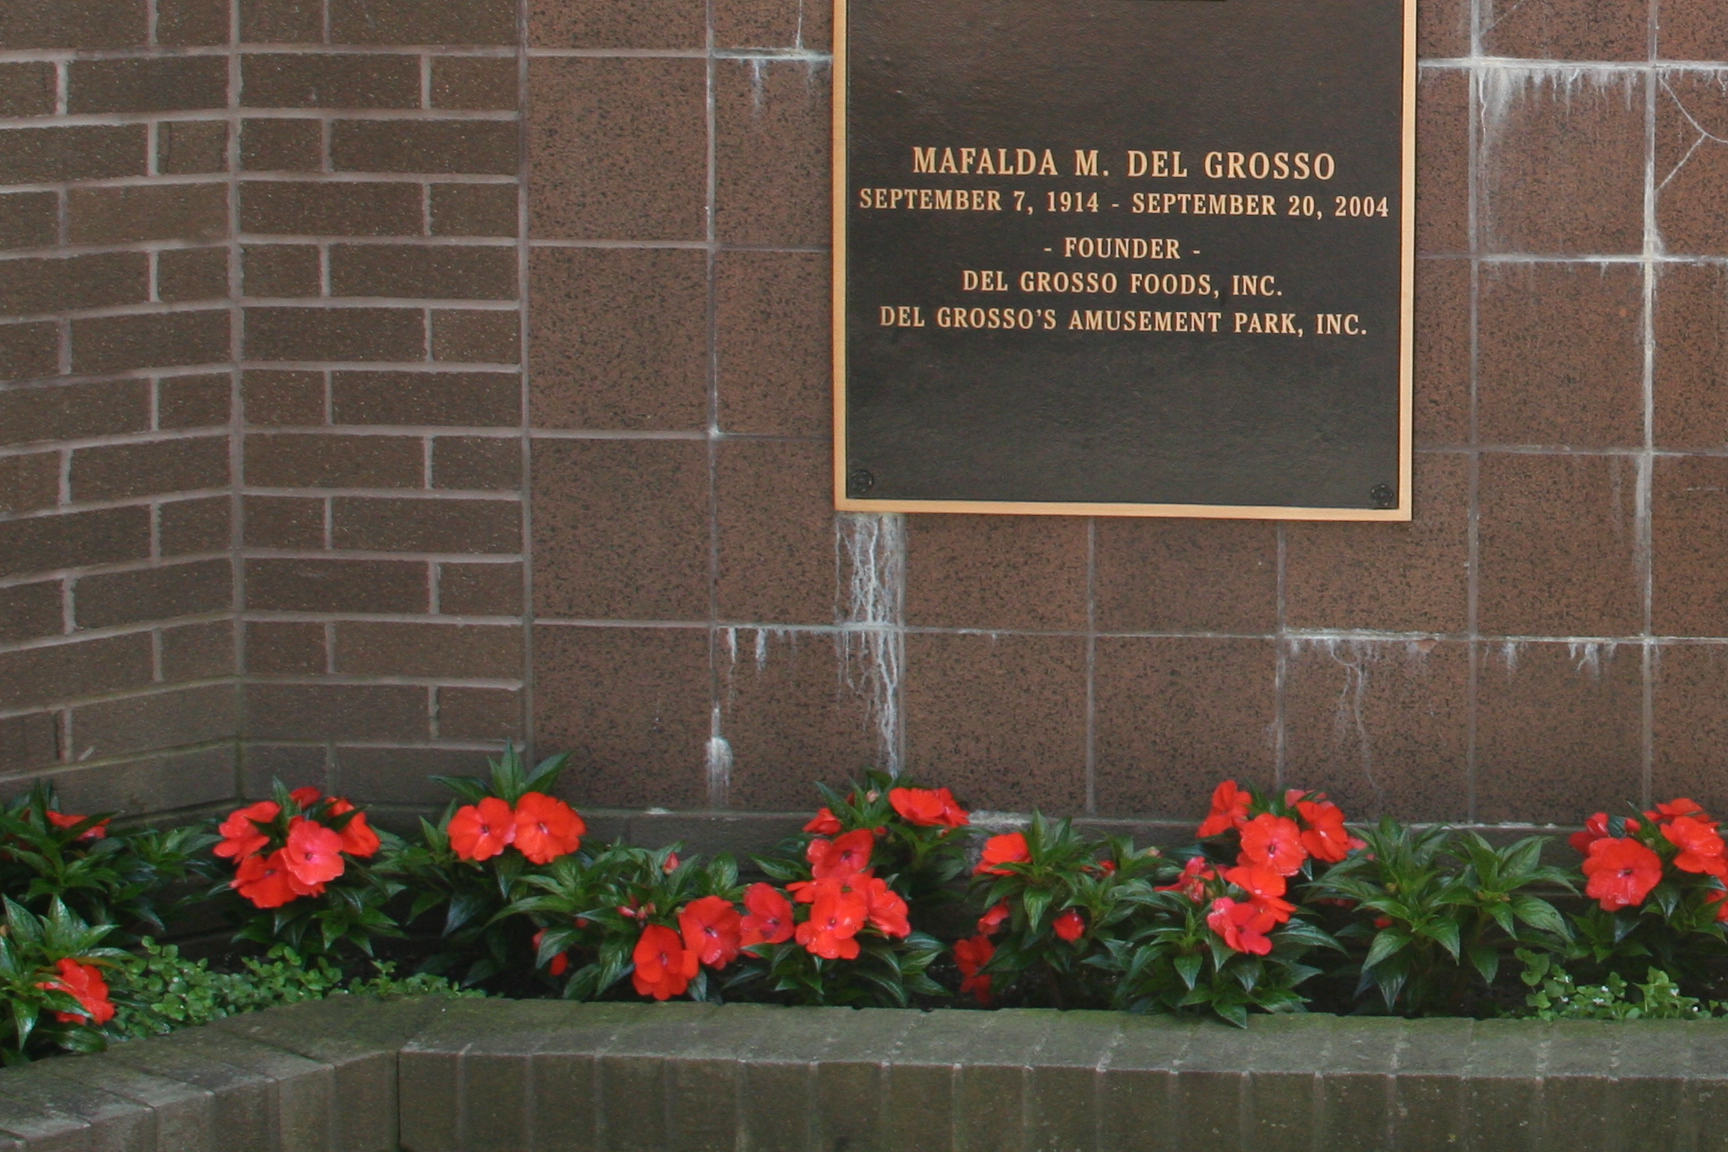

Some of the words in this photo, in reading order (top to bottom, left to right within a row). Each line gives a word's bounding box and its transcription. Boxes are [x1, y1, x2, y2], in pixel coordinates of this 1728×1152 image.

[913, 146, 1058, 176] MAFALDA
[1074, 149, 1110, 177] M.
[1127, 150, 1188, 178] DEL
[1204, 151, 1336, 181] GROSSO
[859, 188, 1002, 211] SEPTEMBER
[1013, 190, 1034, 215] 7,
[1047, 191, 1099, 213] 1914
[1131, 192, 1277, 216] SEPTEMBER
[1288, 195, 1323, 221] 20,
[1334, 195, 1389, 218] 2004
[1064, 237, 1181, 260] FOUNDER
[962, 269, 1008, 292] DEL
[1020, 271, 1118, 294] GROSSO
[1130, 273, 1221, 299] FOODS,
[1232, 275, 1283, 296] INC.
[880, 306, 925, 328] DEL
[936, 307, 1057, 331] GROSSO'S
[1068, 309, 1222, 333] AMUSEMENT
[1234, 312, 1304, 338] PARK,
[1315, 313, 1367, 336] INC.
